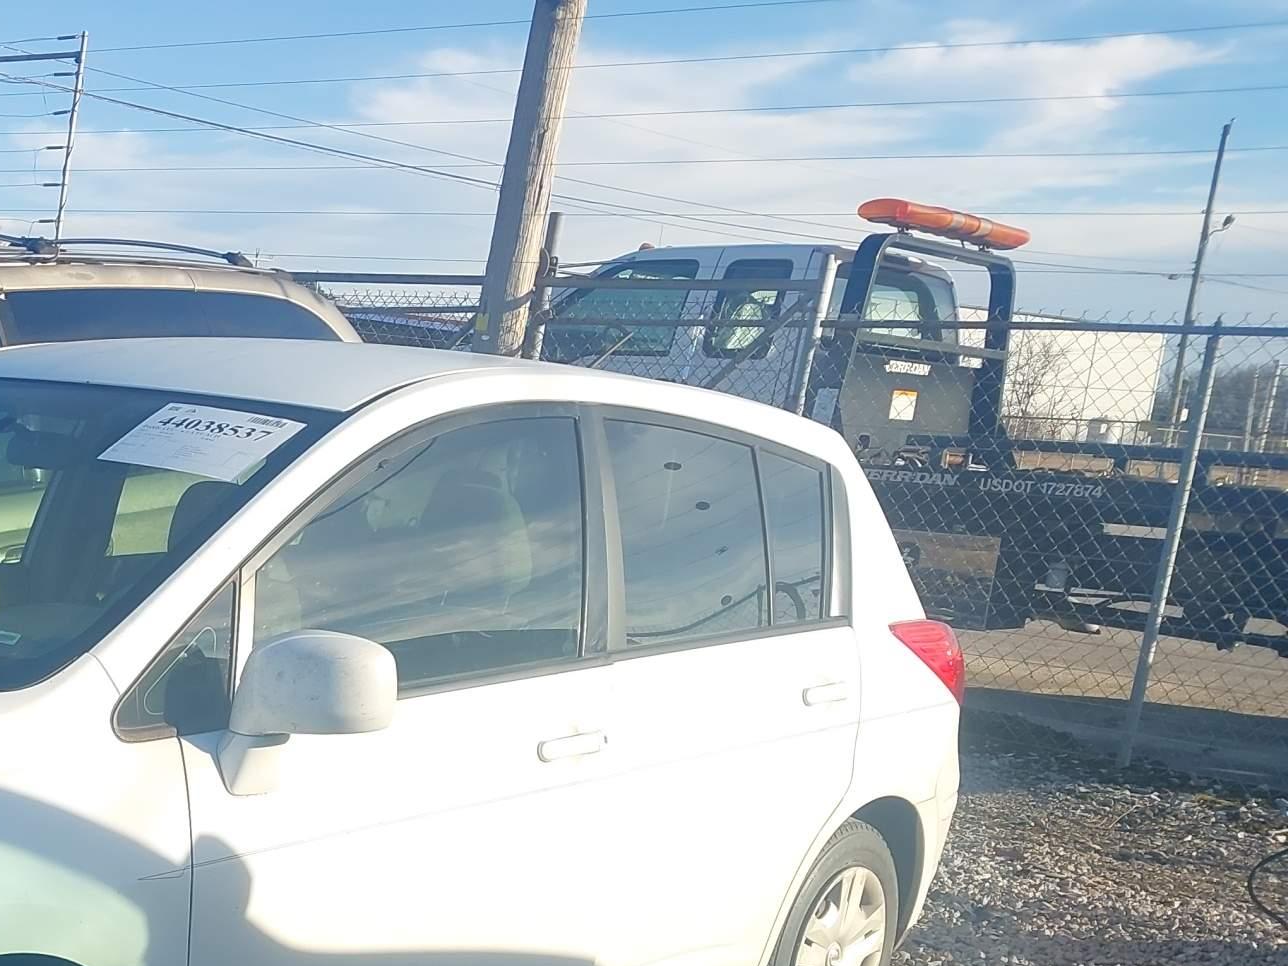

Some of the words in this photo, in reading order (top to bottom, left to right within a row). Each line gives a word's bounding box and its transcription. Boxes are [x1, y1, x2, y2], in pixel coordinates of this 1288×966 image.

[158, 415, 274, 442] 44038537
[979, 478, 1035, 493] USDOT
[1040, 482, 1103, 498] 1727874
